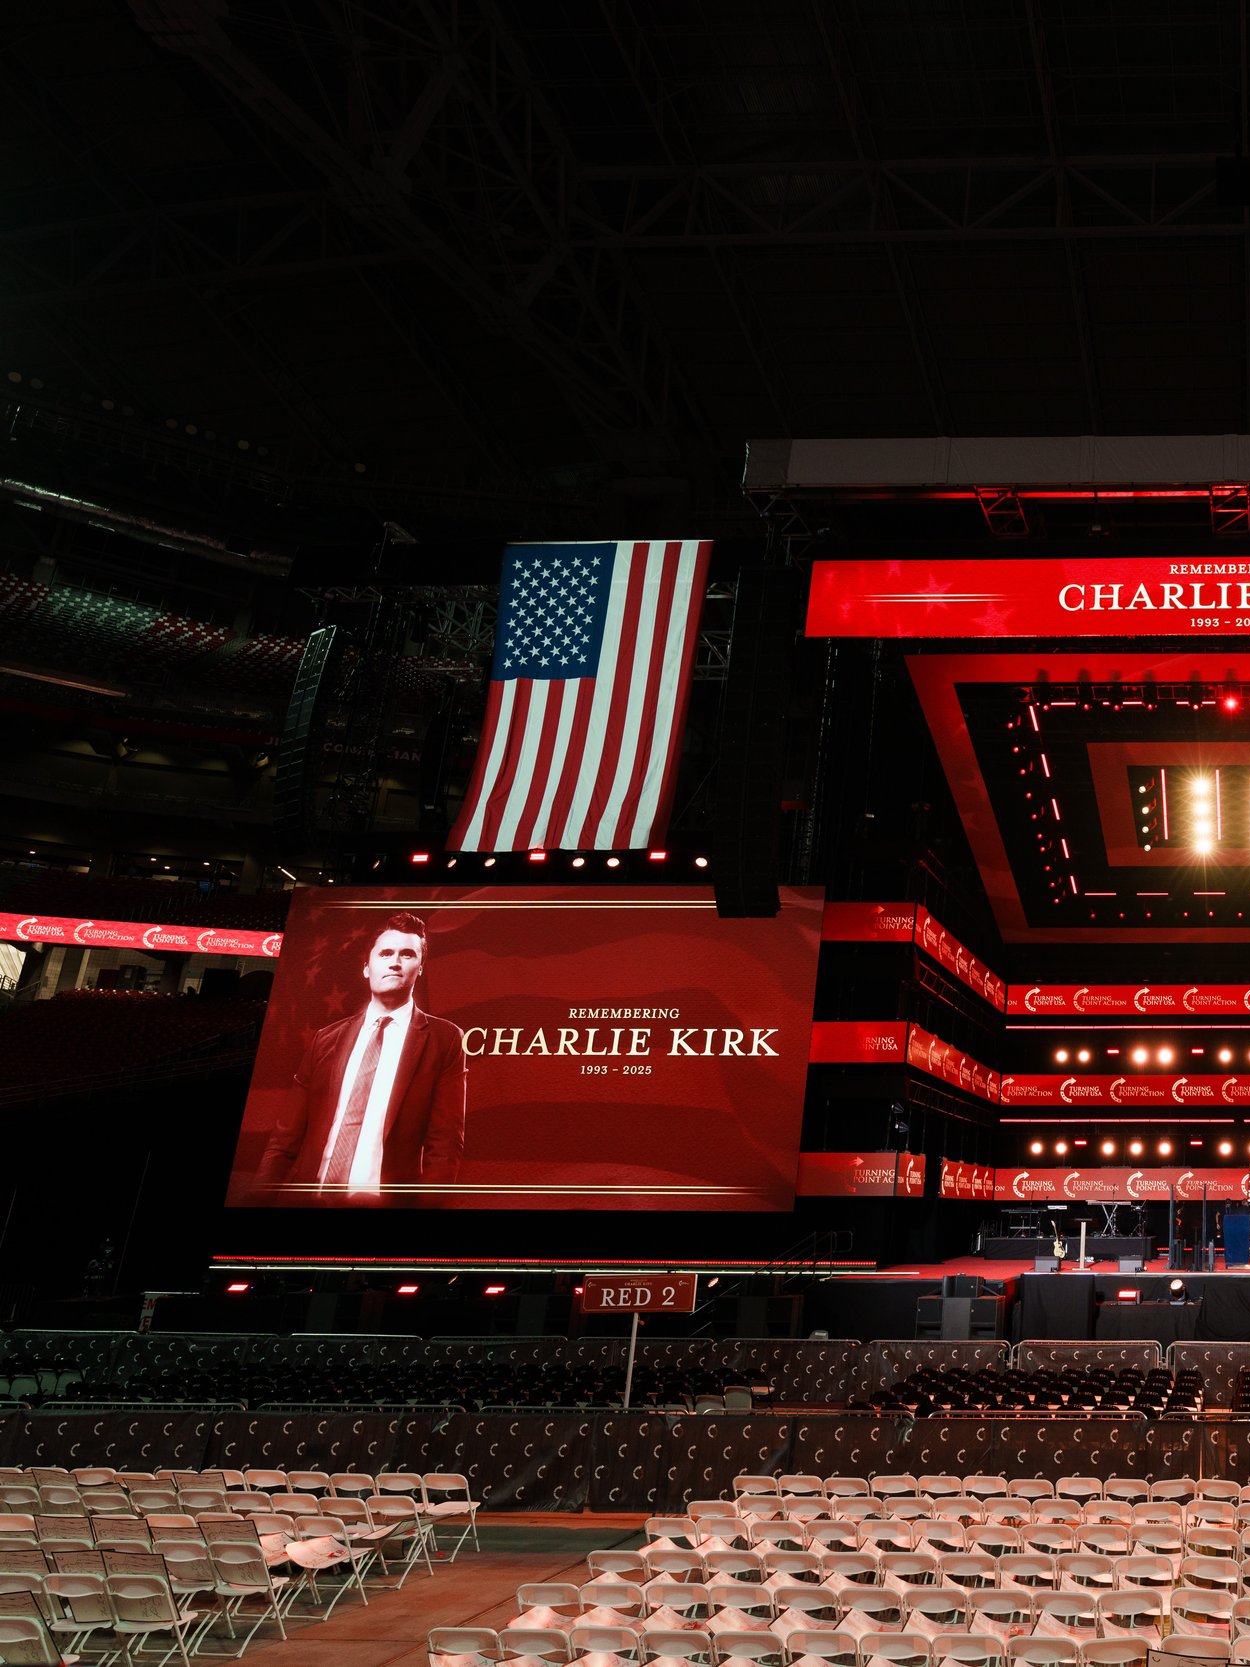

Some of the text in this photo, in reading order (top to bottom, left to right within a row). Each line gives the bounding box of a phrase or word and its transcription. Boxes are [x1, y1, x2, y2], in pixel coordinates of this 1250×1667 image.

[1190, 618, 1220, 628] 1993
[568, 1008, 680, 1019] REMEMBERING
[462, 1027, 779, 1056] CHARLIE KIRK
[580, 1065, 608, 1075] 1993
[623, 1065, 652, 1075] 2025
[854, 1169, 895, 1177] TURNING
[600, 1286, 675, 1307] RED 2
